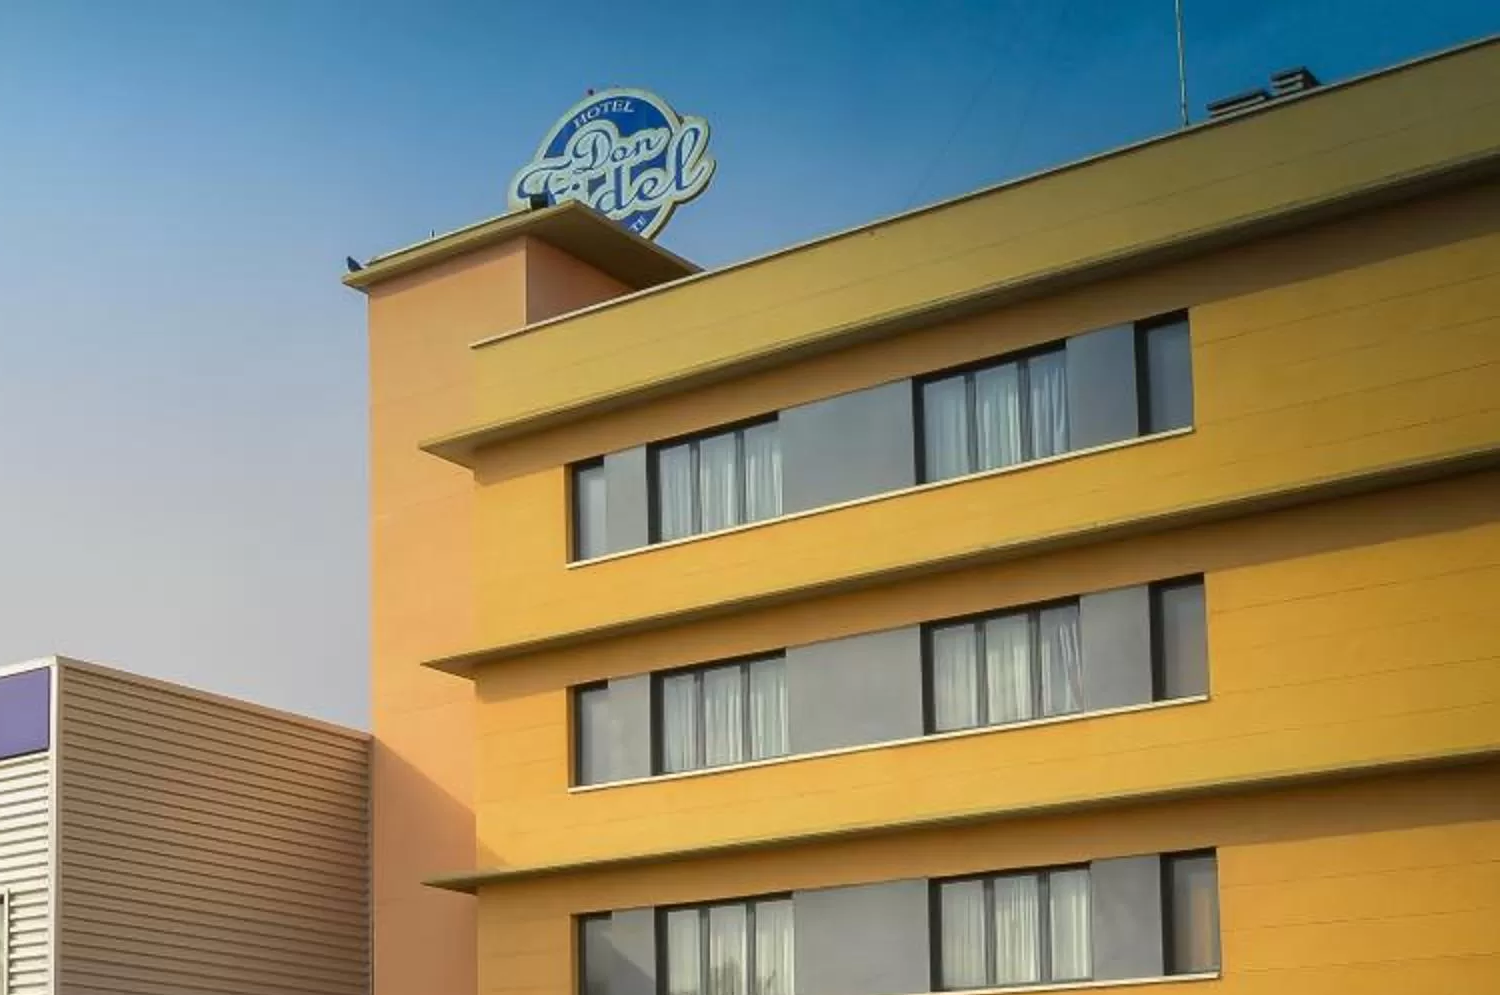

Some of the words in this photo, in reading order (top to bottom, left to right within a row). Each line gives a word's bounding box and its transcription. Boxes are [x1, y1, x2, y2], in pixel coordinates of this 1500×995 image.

[572, 99, 636, 129] HOTEL
[517, 125, 706, 212] Fdel
[573, 129, 664, 173] Don
